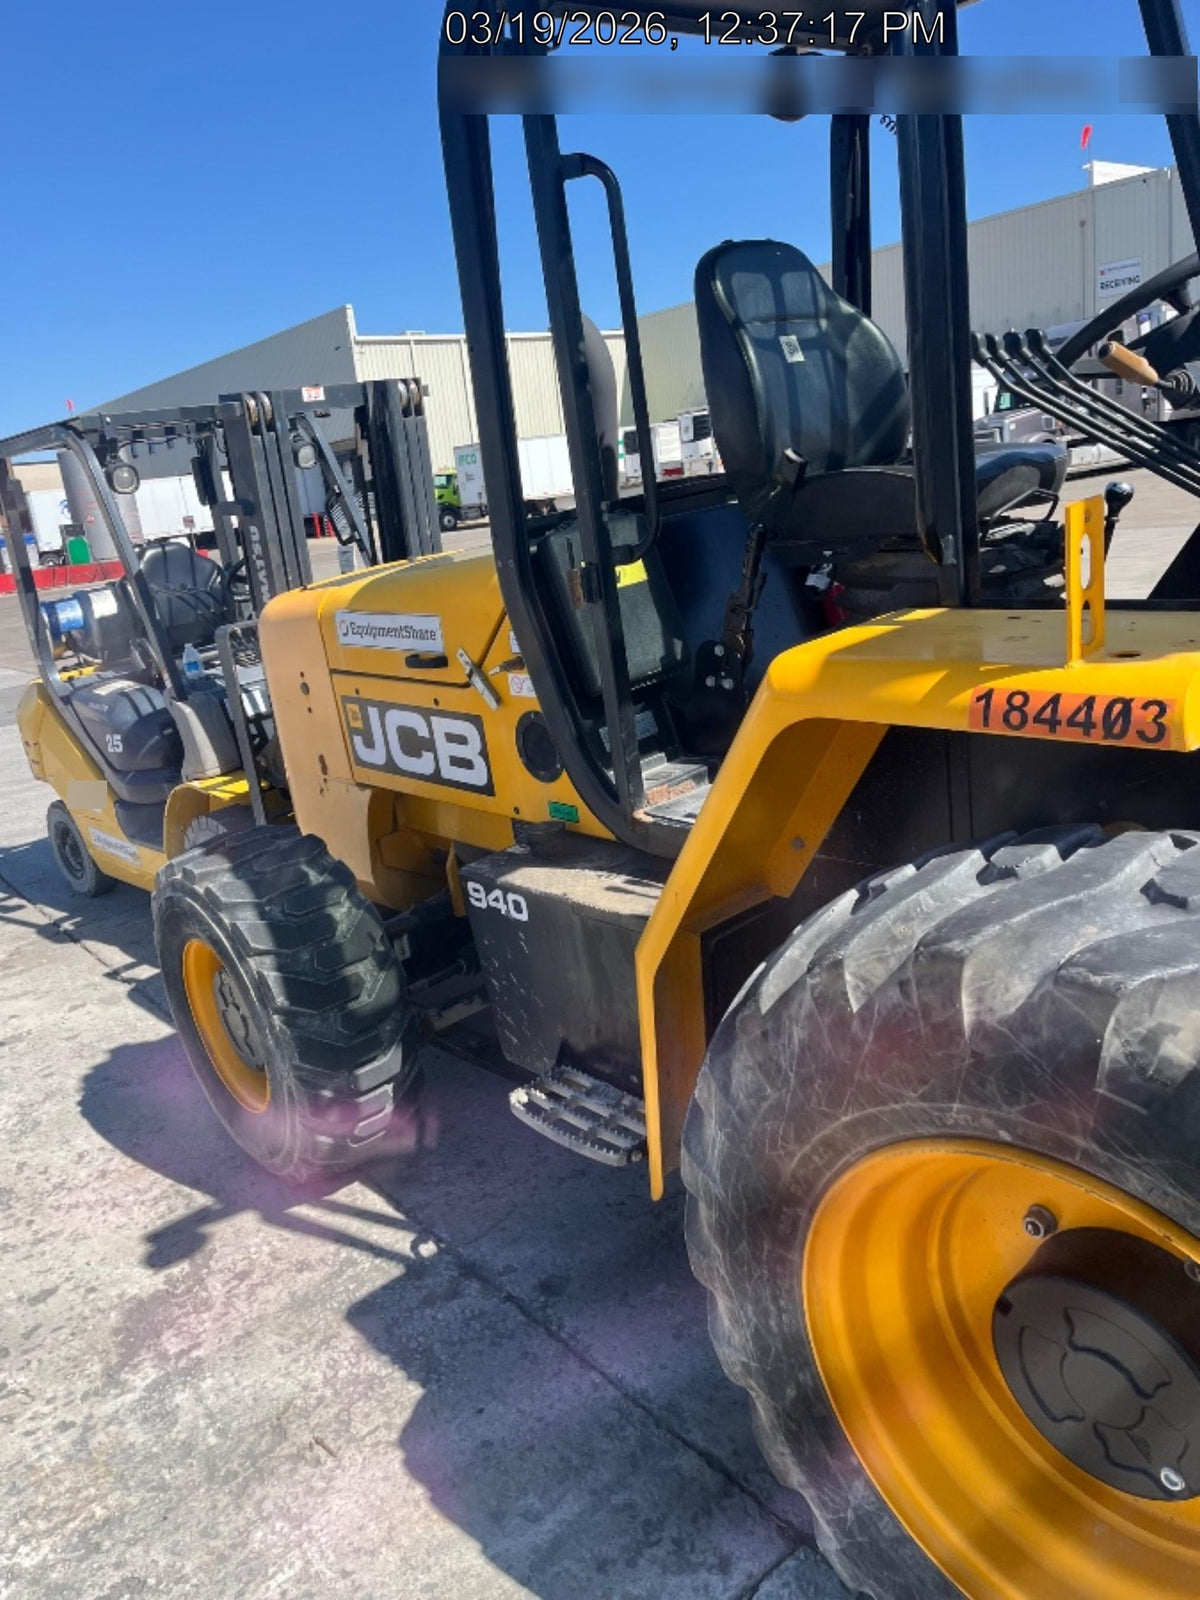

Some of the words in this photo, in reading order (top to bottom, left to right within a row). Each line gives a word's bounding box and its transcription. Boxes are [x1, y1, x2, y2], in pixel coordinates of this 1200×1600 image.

[1100, 274, 1140, 290] RECEIVING
[350, 621, 437, 641] EquipmentShare
[106, 733, 123, 753] 25
[353, 705, 488, 787] JCB
[467, 881, 529, 922] 940
